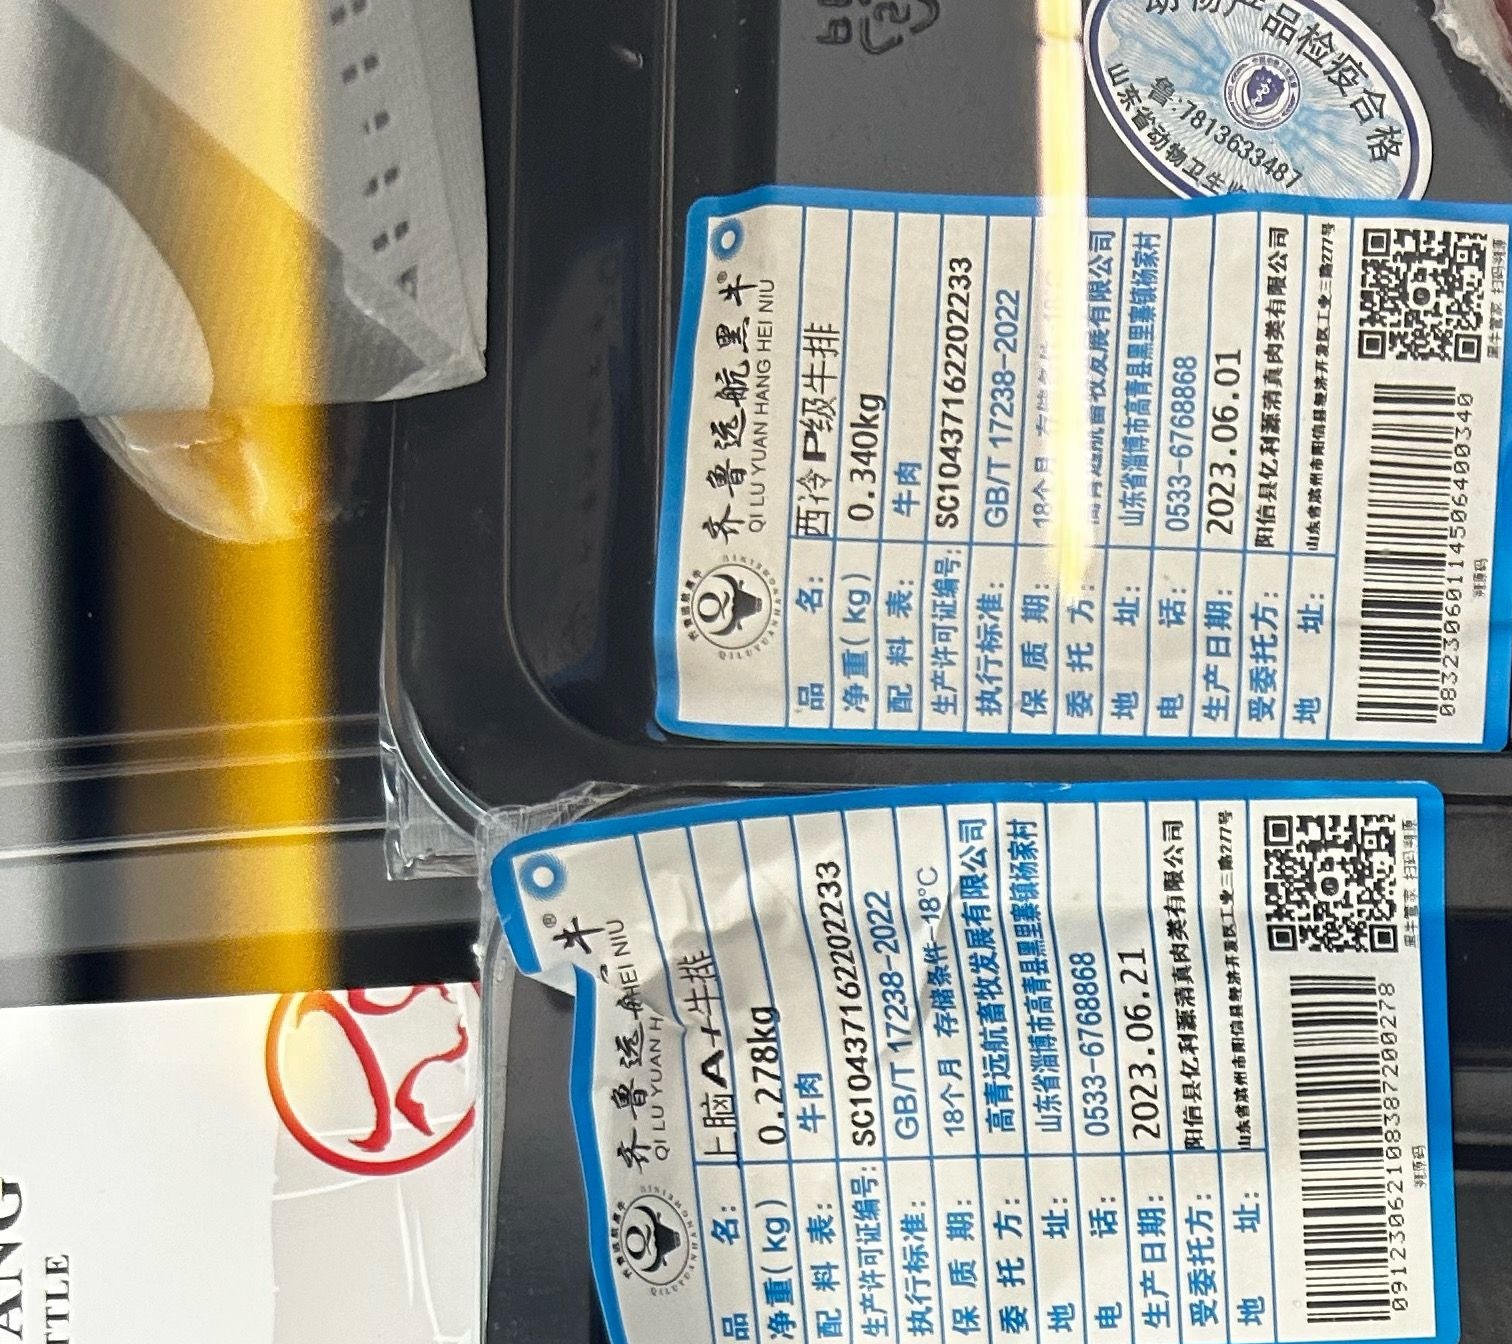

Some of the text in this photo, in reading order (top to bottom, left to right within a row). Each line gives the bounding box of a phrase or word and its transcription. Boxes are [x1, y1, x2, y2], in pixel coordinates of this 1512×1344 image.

[702, 273, 757, 546] 齐鲁远航黑牛
[750, 279, 774, 533] QI LU YUAN HANG HEI NIU
[795, 322, 840, 537] 西冷P级牛排
[936, 257, 971, 529] SC10437162202233
[989, 289, 1019, 449] 17238-2022
[1164, 355, 1196, 531] 0533-6768868
[1206, 348, 1242, 536] 2023.06.01
[847, 393, 886, 522] 0.340kg
[893, 461, 922, 518] 牛肉
[984, 456, 1011, 529] GB/T
[1440, 393, 1474, 716] 08323060114506400340
[606, 919, 631, 957] NIU
[815, 861, 877, 1147] SC10437162202233
[865, 890, 915, 1052] 17238-2022
[957, 817, 1017, 1133] 高青远航畜牧发展有限公司
[1005, 818, 1064, 1133] 山东省淄博市高青县黑里寨镇杨家村
[649, 1047, 663, 1097] YUAN
[652, 1106, 665, 1131] LU
[746, 1006, 786, 1145] 0.278kg
[794, 1072, 826, 1133] 牛肉
[890, 1061, 921, 1140] GB/T
[935, 1058, 966, 1137] 18个月
[1068, 952, 1110, 1136] 0533-6768868
[1117, 948, 1162, 1140] 2023.06.21
[654, 1140, 669, 1160] QI
[1376, 982, 1408, 1311] 09123062108387200278
